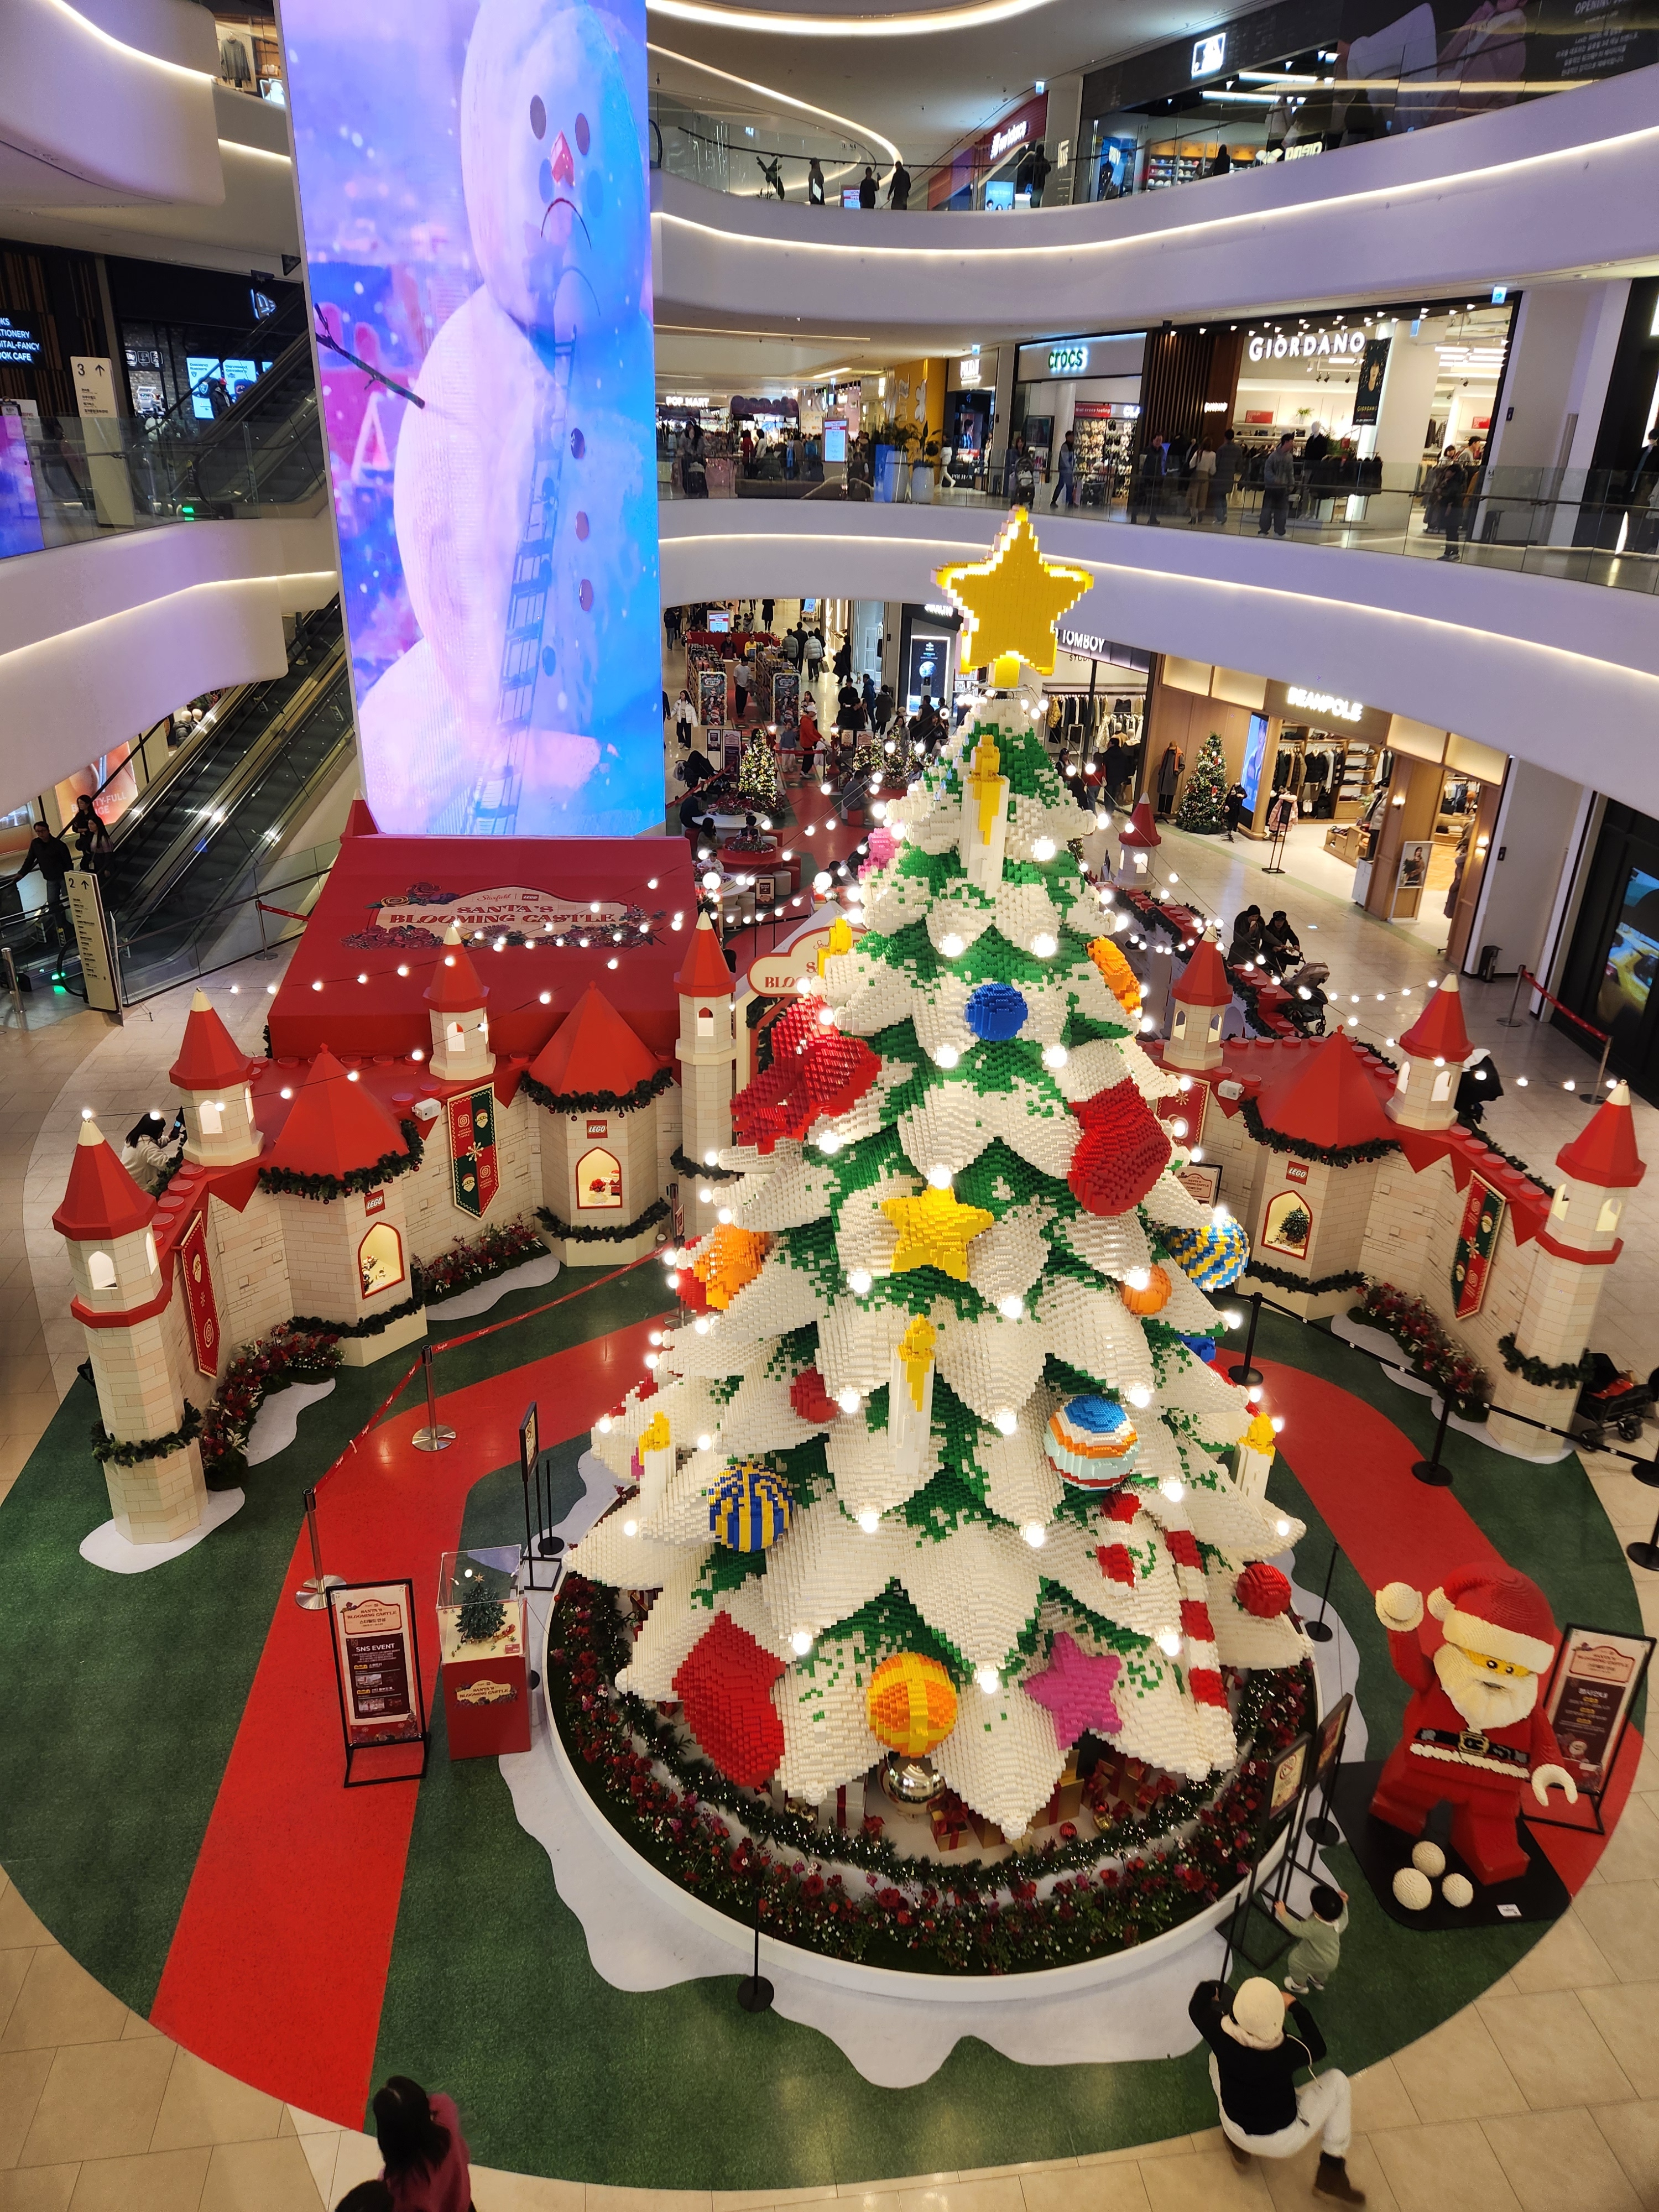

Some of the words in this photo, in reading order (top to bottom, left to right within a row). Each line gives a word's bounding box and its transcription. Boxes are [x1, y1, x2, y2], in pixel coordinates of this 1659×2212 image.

[0, 317, 11, 326] KS
[0, 329, 30, 339] TIONERY
[0, 341, 40, 350] ITAL-FANCY
[1249, 331, 1366, 362] GIORDANO
[13, 352, 32, 361] CAFE
[1048, 349, 1083, 369] crocs
[77, 363, 85, 375] 3
[666, 396, 684, 407] POP
[685, 397, 709, 408] MART
[1287, 686, 1364, 722] BEANPOLE
[69, 878, 75, 888] 2
[477, 893, 512, 902] Starfield
[457, 904, 554, 914] SANTA'S
[389, 914, 515, 924] BLOOMING
[523, 914, 615, 923] CASTLE
[1288, 1168, 1306, 1177] LEGO
[367, 1197, 383, 1209] LEGO
